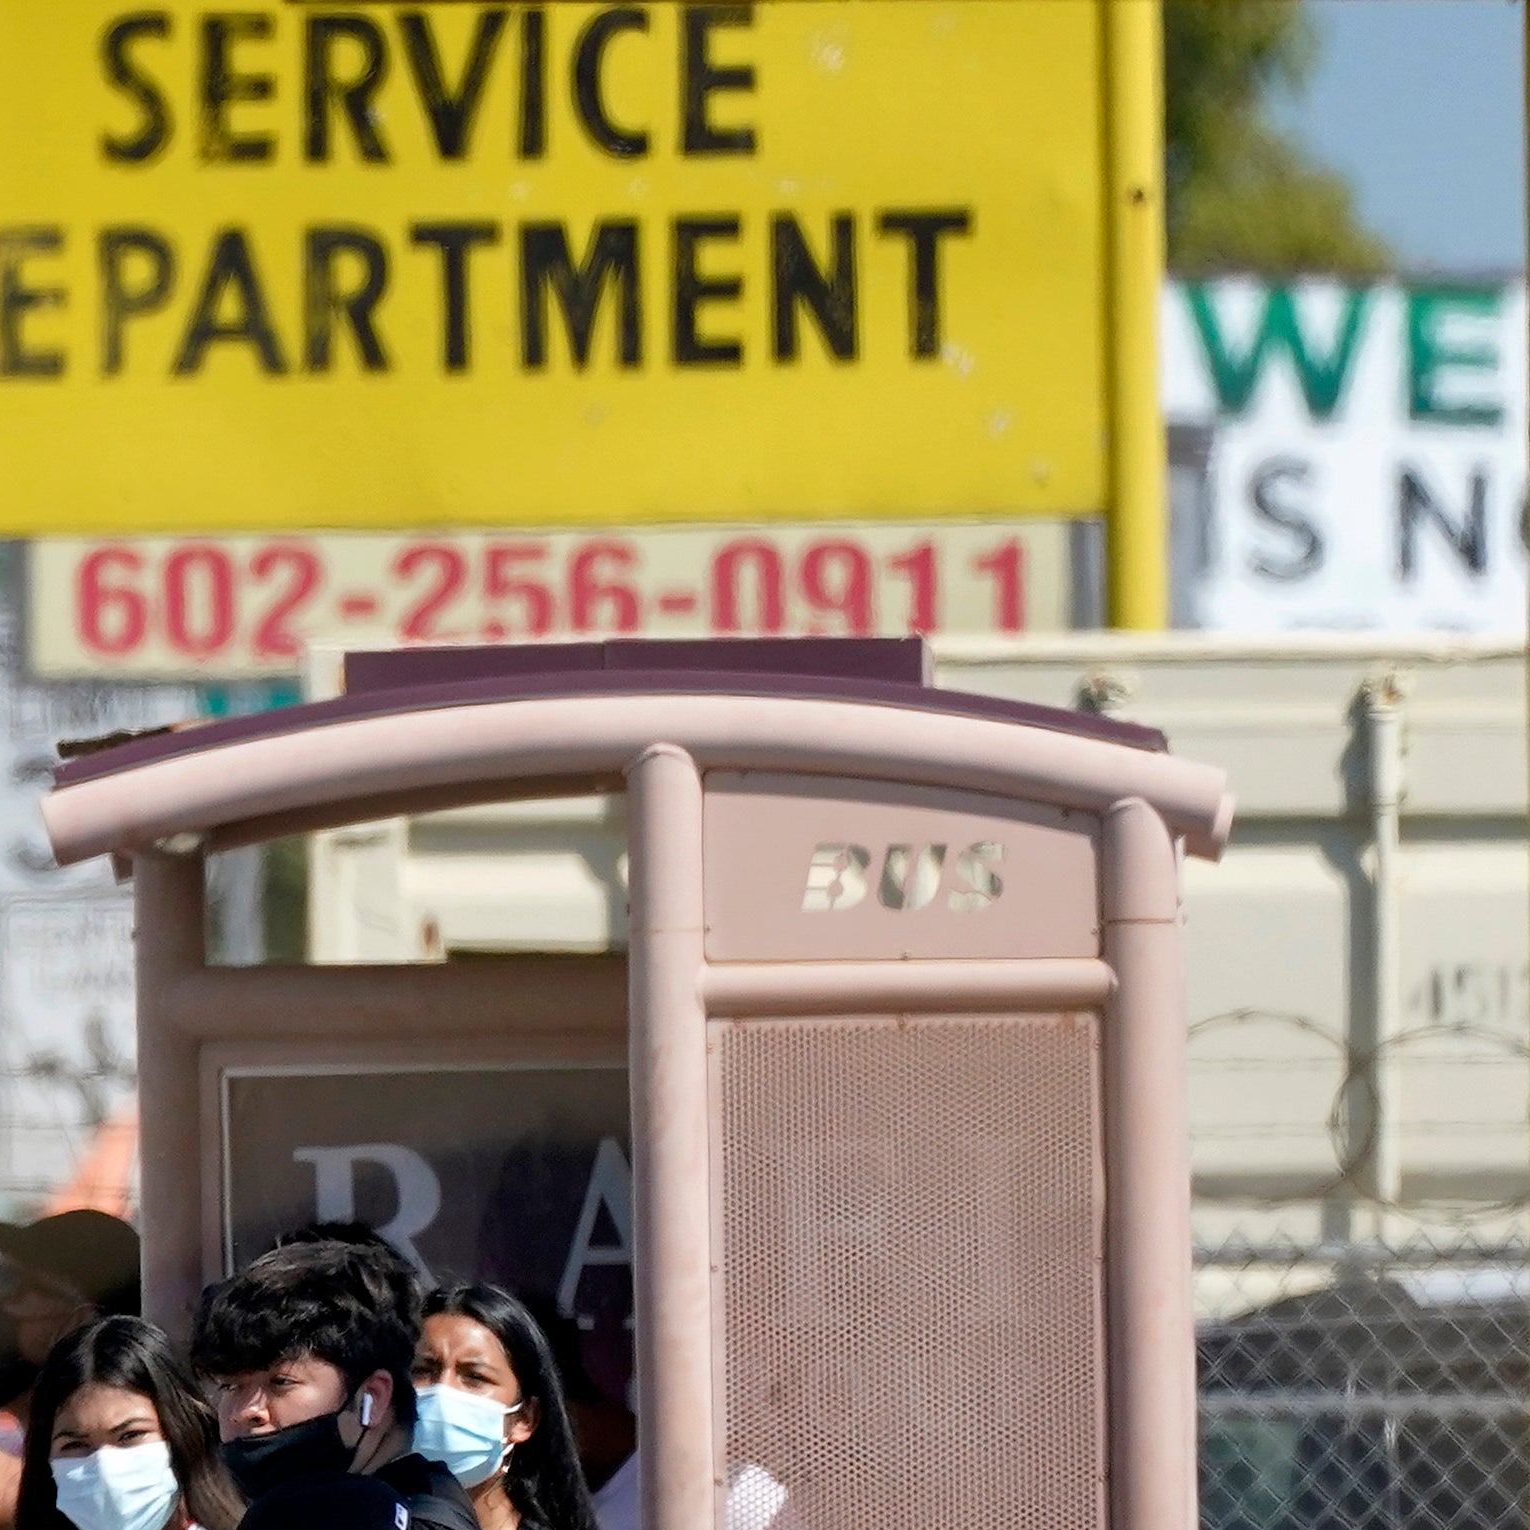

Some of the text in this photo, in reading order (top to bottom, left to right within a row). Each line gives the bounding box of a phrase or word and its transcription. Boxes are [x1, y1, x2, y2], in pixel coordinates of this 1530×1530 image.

[98, 5, 757, 167] SERVICE
[1398, 460, 1526, 585] N
[74, 536, 1025, 660] 602-256-0911
[800, 840, 1006, 913] BUS
